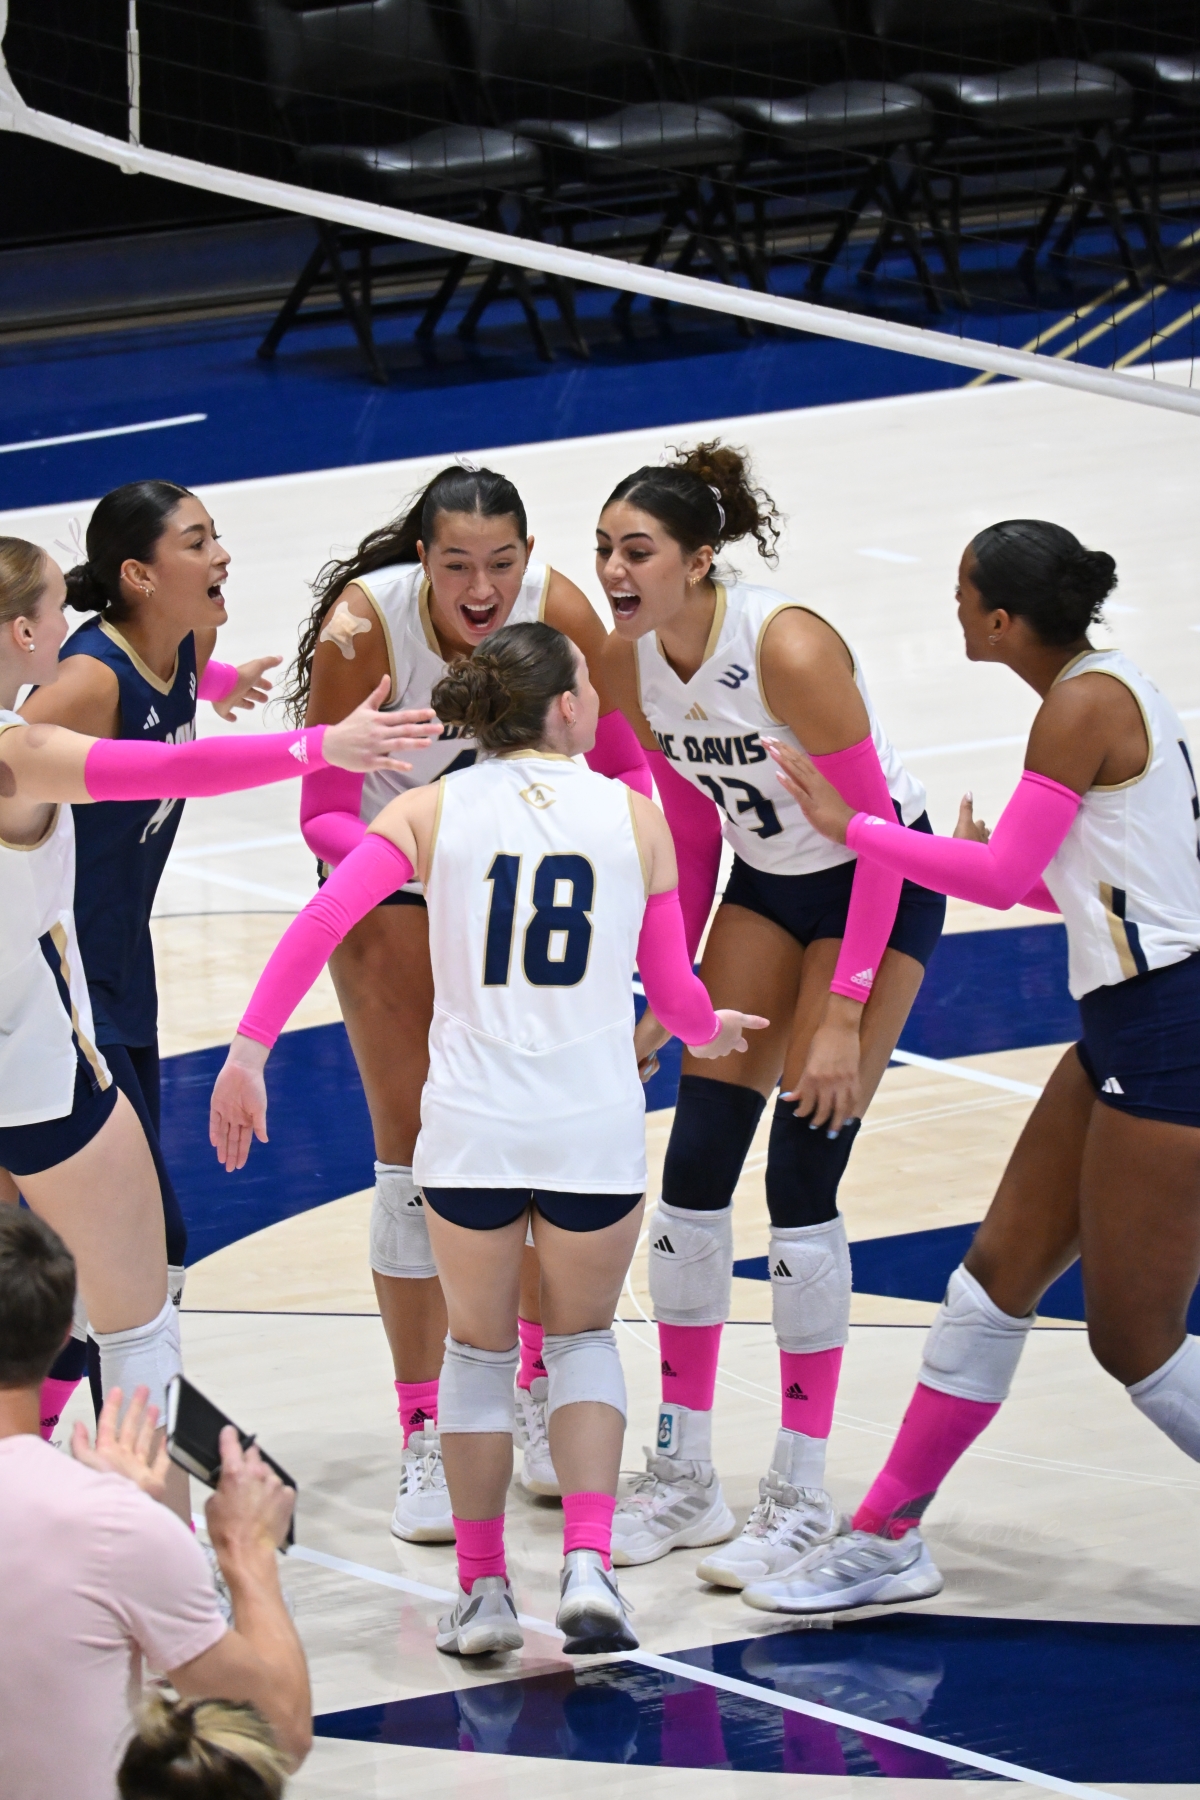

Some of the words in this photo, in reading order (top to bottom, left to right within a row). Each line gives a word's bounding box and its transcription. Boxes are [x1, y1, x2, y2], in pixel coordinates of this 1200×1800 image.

[682, 730, 770, 767] DAVIS
[695, 773, 784, 840] 13
[481, 851, 598, 989] 18
